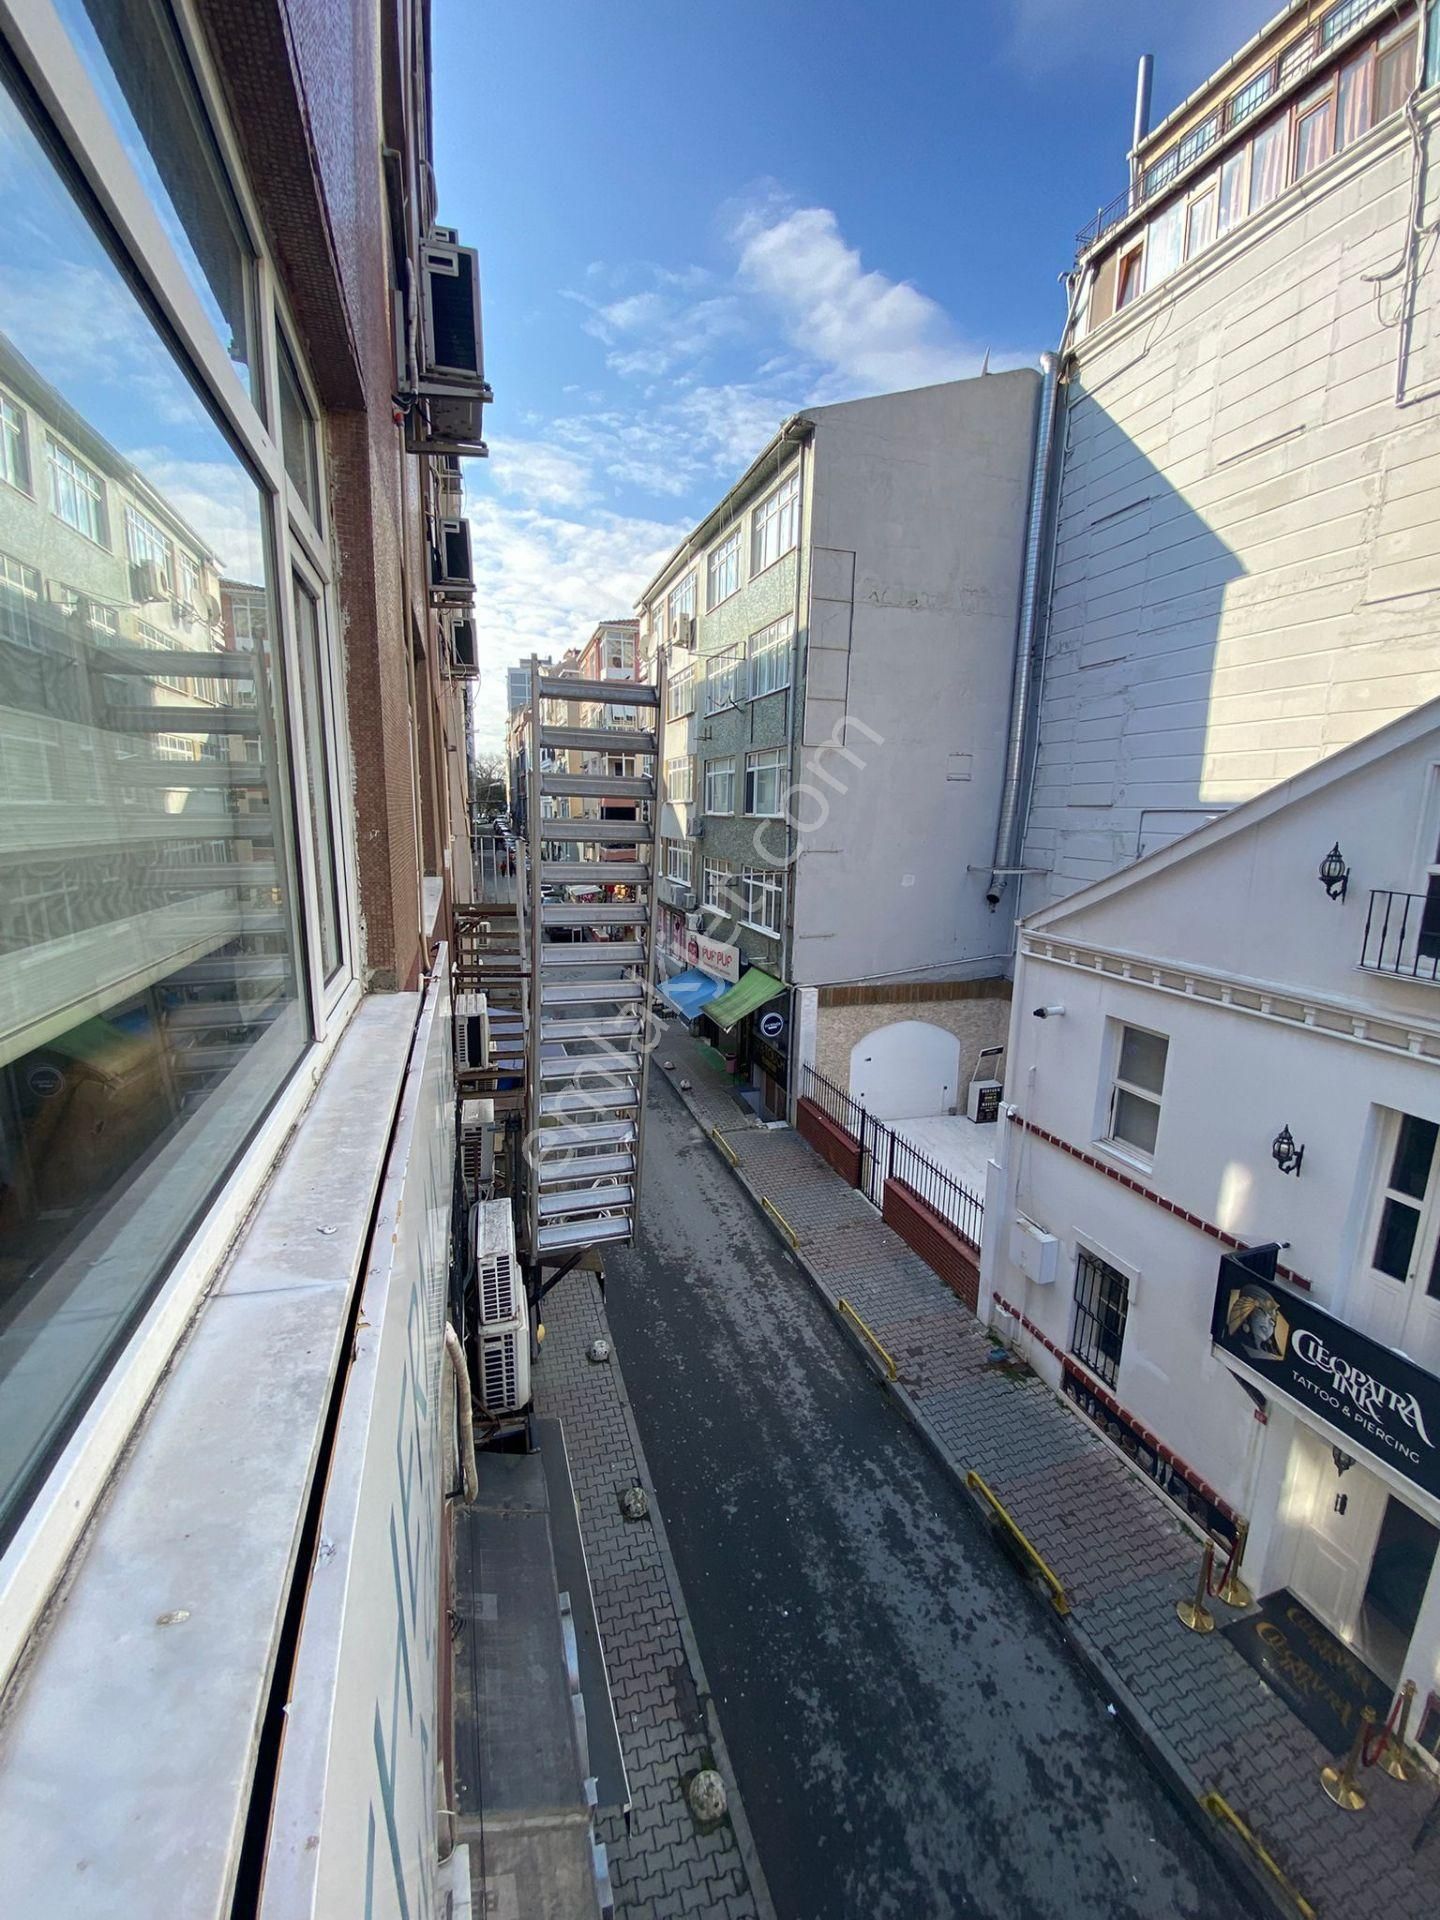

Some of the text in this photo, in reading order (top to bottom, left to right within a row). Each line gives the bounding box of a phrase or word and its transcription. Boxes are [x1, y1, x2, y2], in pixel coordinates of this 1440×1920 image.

[1291, 1328, 1436, 1449] CLEOPATRA
[1292, 1369, 1421, 1464] TATTOO & PIERCING
[1332, 1370, 1384, 1425] INK
